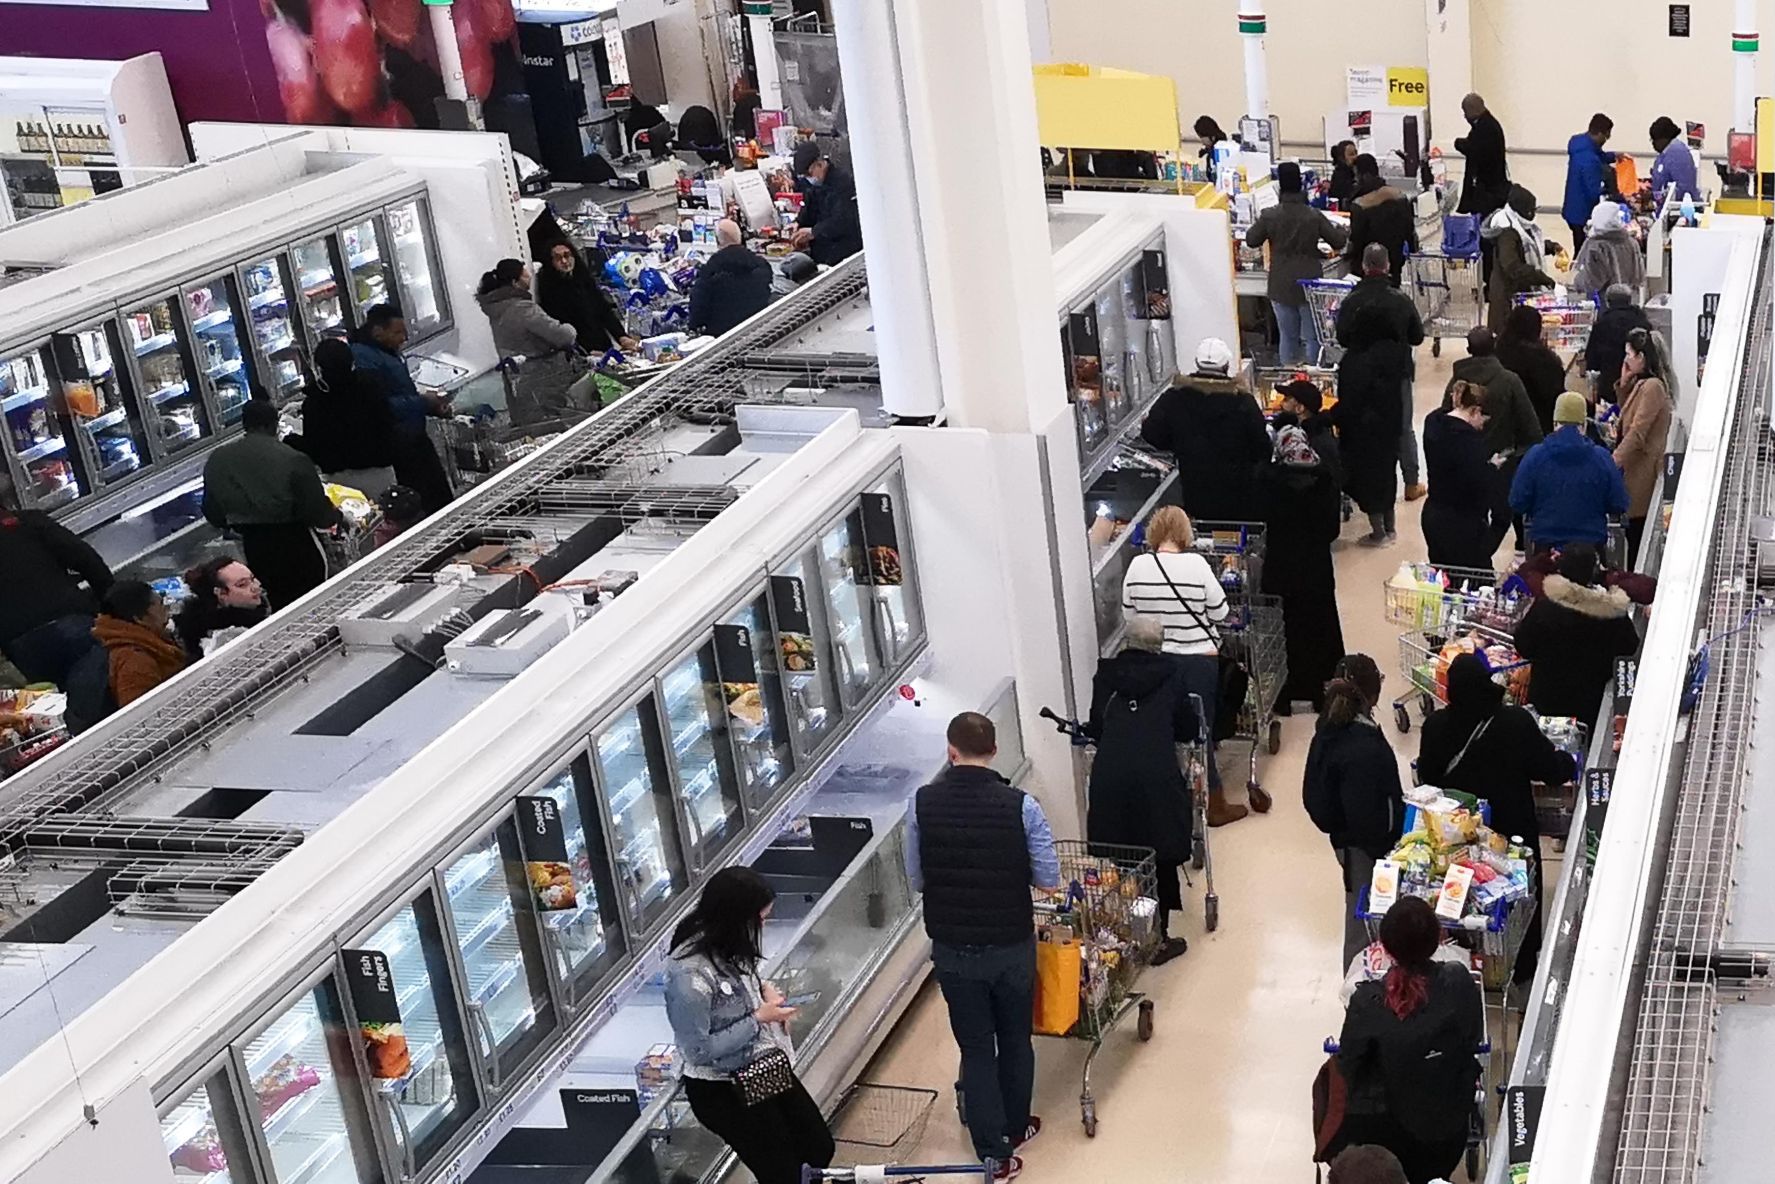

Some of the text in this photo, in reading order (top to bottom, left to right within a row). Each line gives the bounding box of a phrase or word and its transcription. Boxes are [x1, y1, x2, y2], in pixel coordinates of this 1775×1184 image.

[1389, 78, 1425, 93] Free
[537, 800, 547, 835] Coated
[545, 800, 555, 820] Fish
[360, 955, 373, 976] Fish
[374, 955, 389, 992] Fingers
[577, 1094, 631, 1103] Coated Fish
[1514, 1091, 1526, 1147] Vegetables
